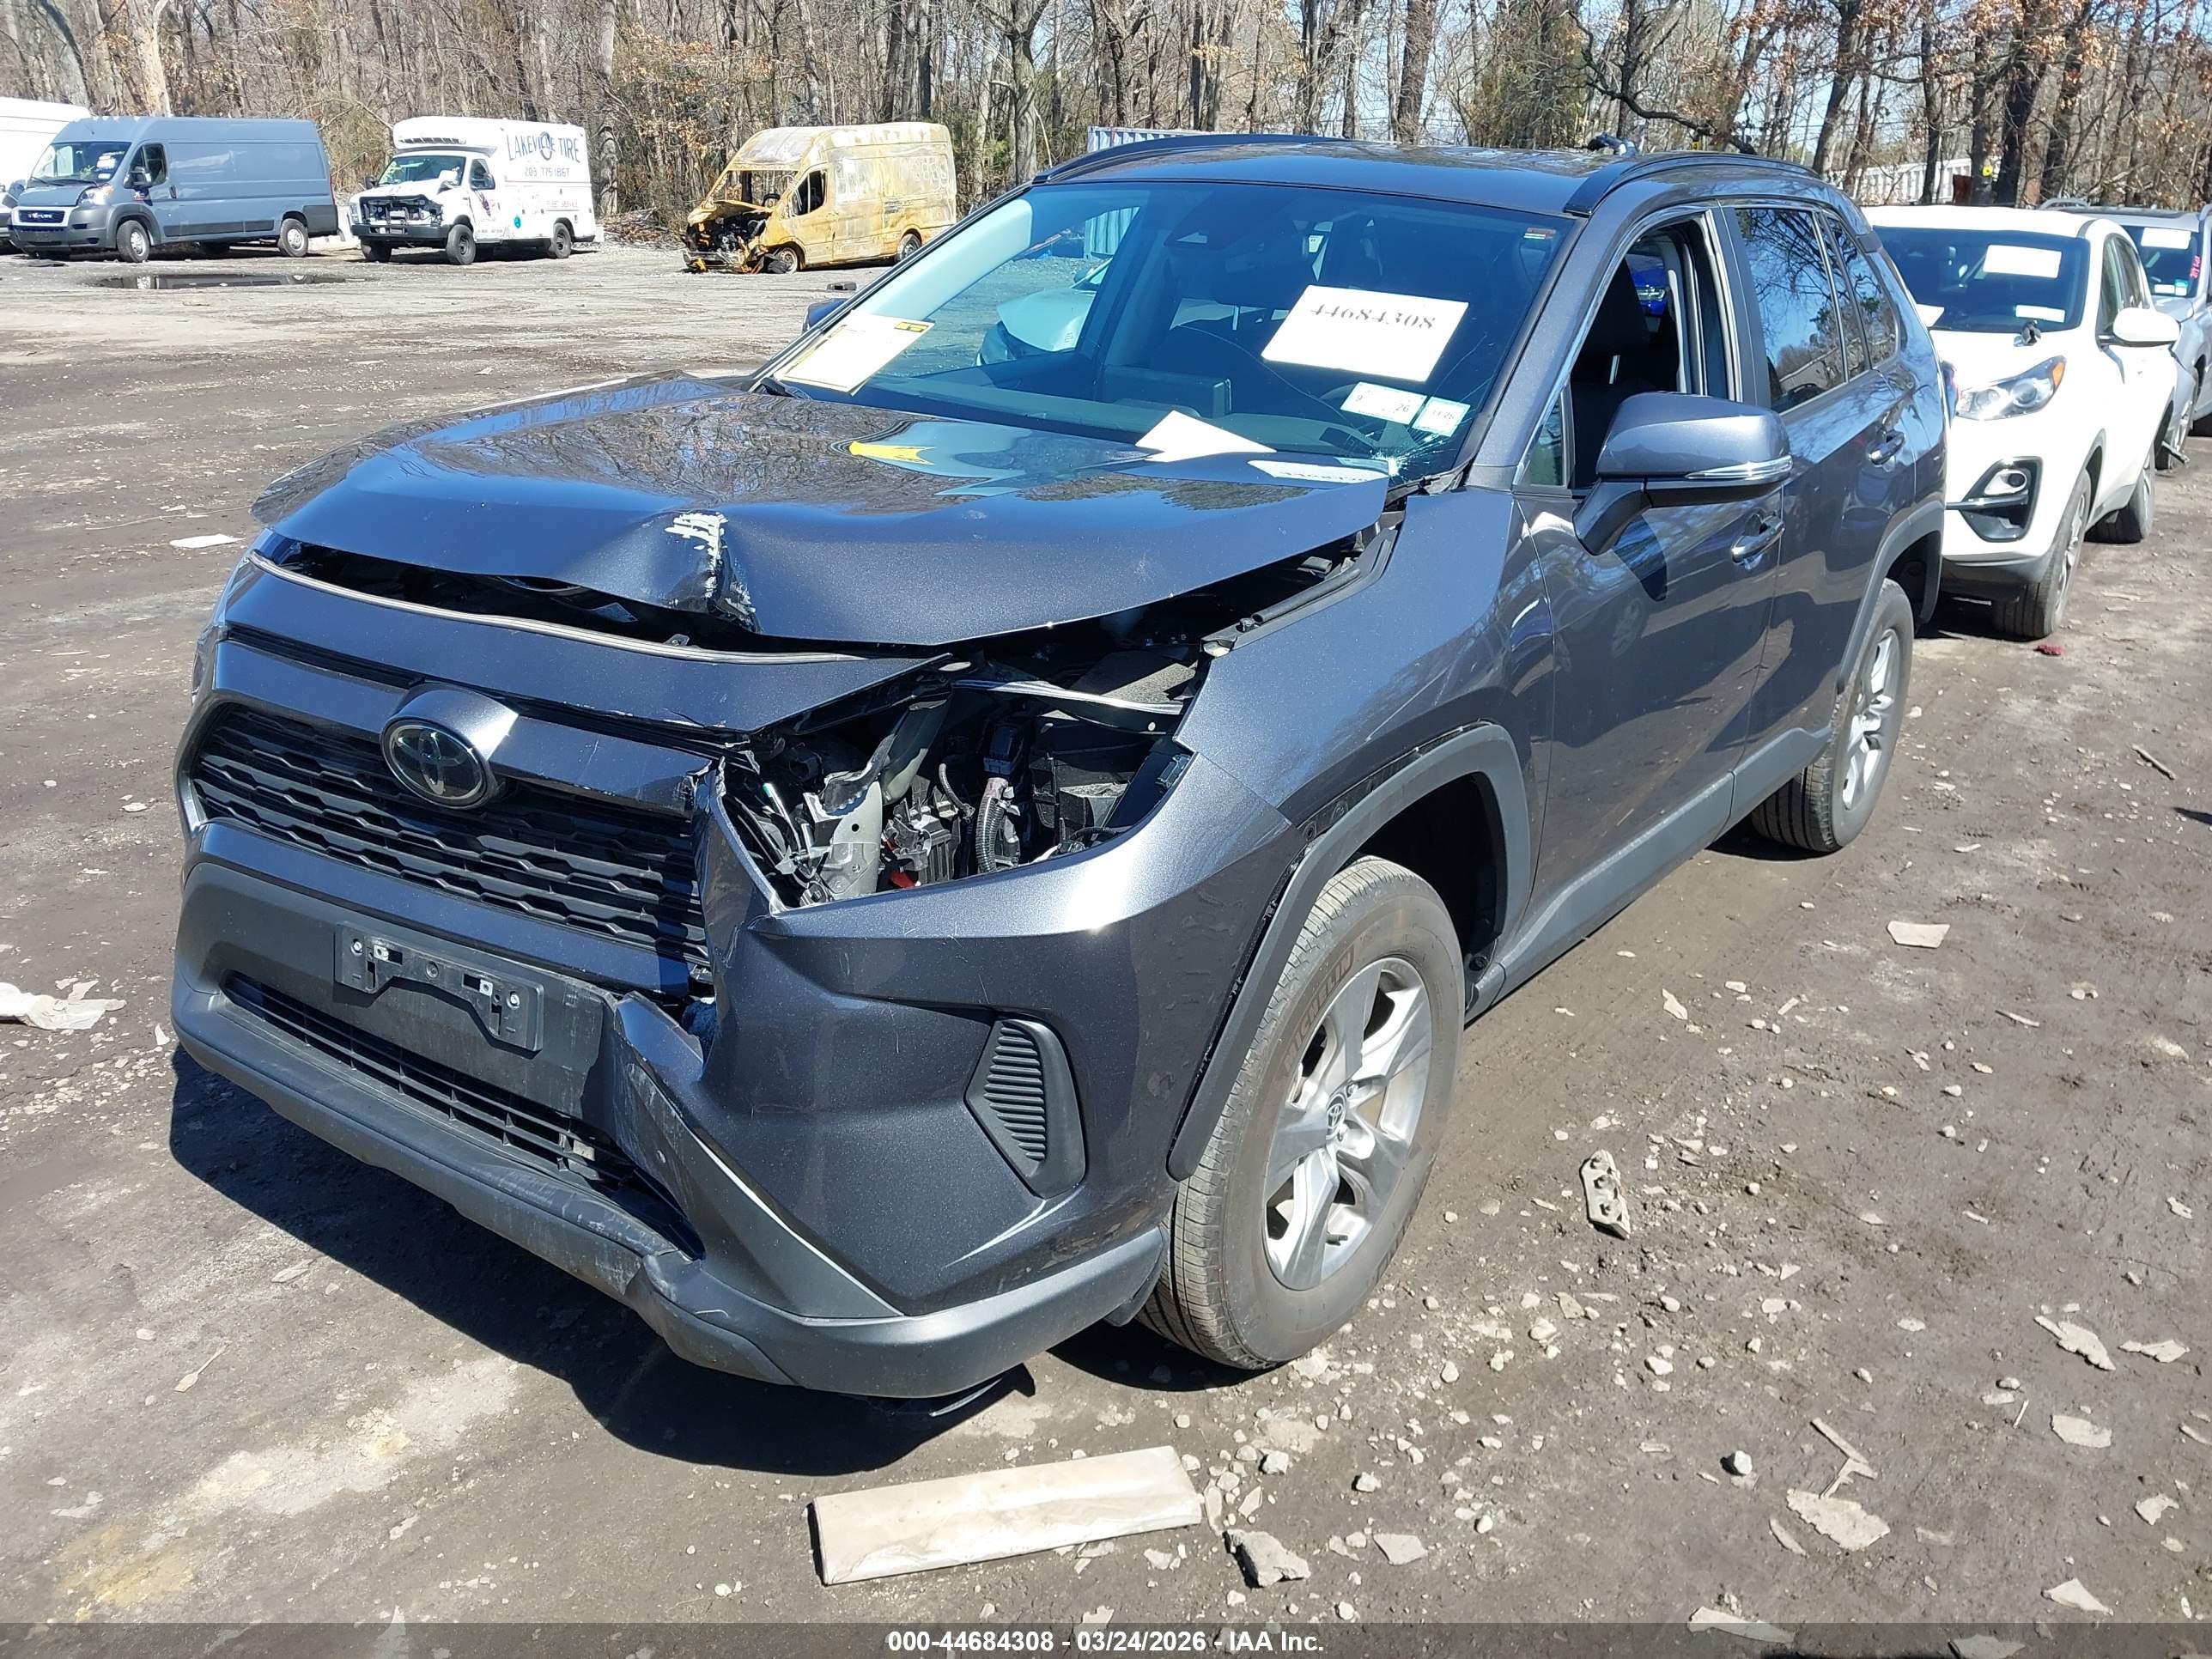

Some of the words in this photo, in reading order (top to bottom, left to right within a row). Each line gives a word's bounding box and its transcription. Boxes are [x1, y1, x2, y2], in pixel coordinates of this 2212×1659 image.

[507, 134, 556, 161] LAKEVILLE
[558, 137, 580, 163] TIRE
[525, 167, 538, 177] 203
[540, 167, 553, 177] 775
[554, 167, 570, 178] 1867
[1310, 303, 1436, 330] 44684308
[1395, 403, 1410, 413] 26
